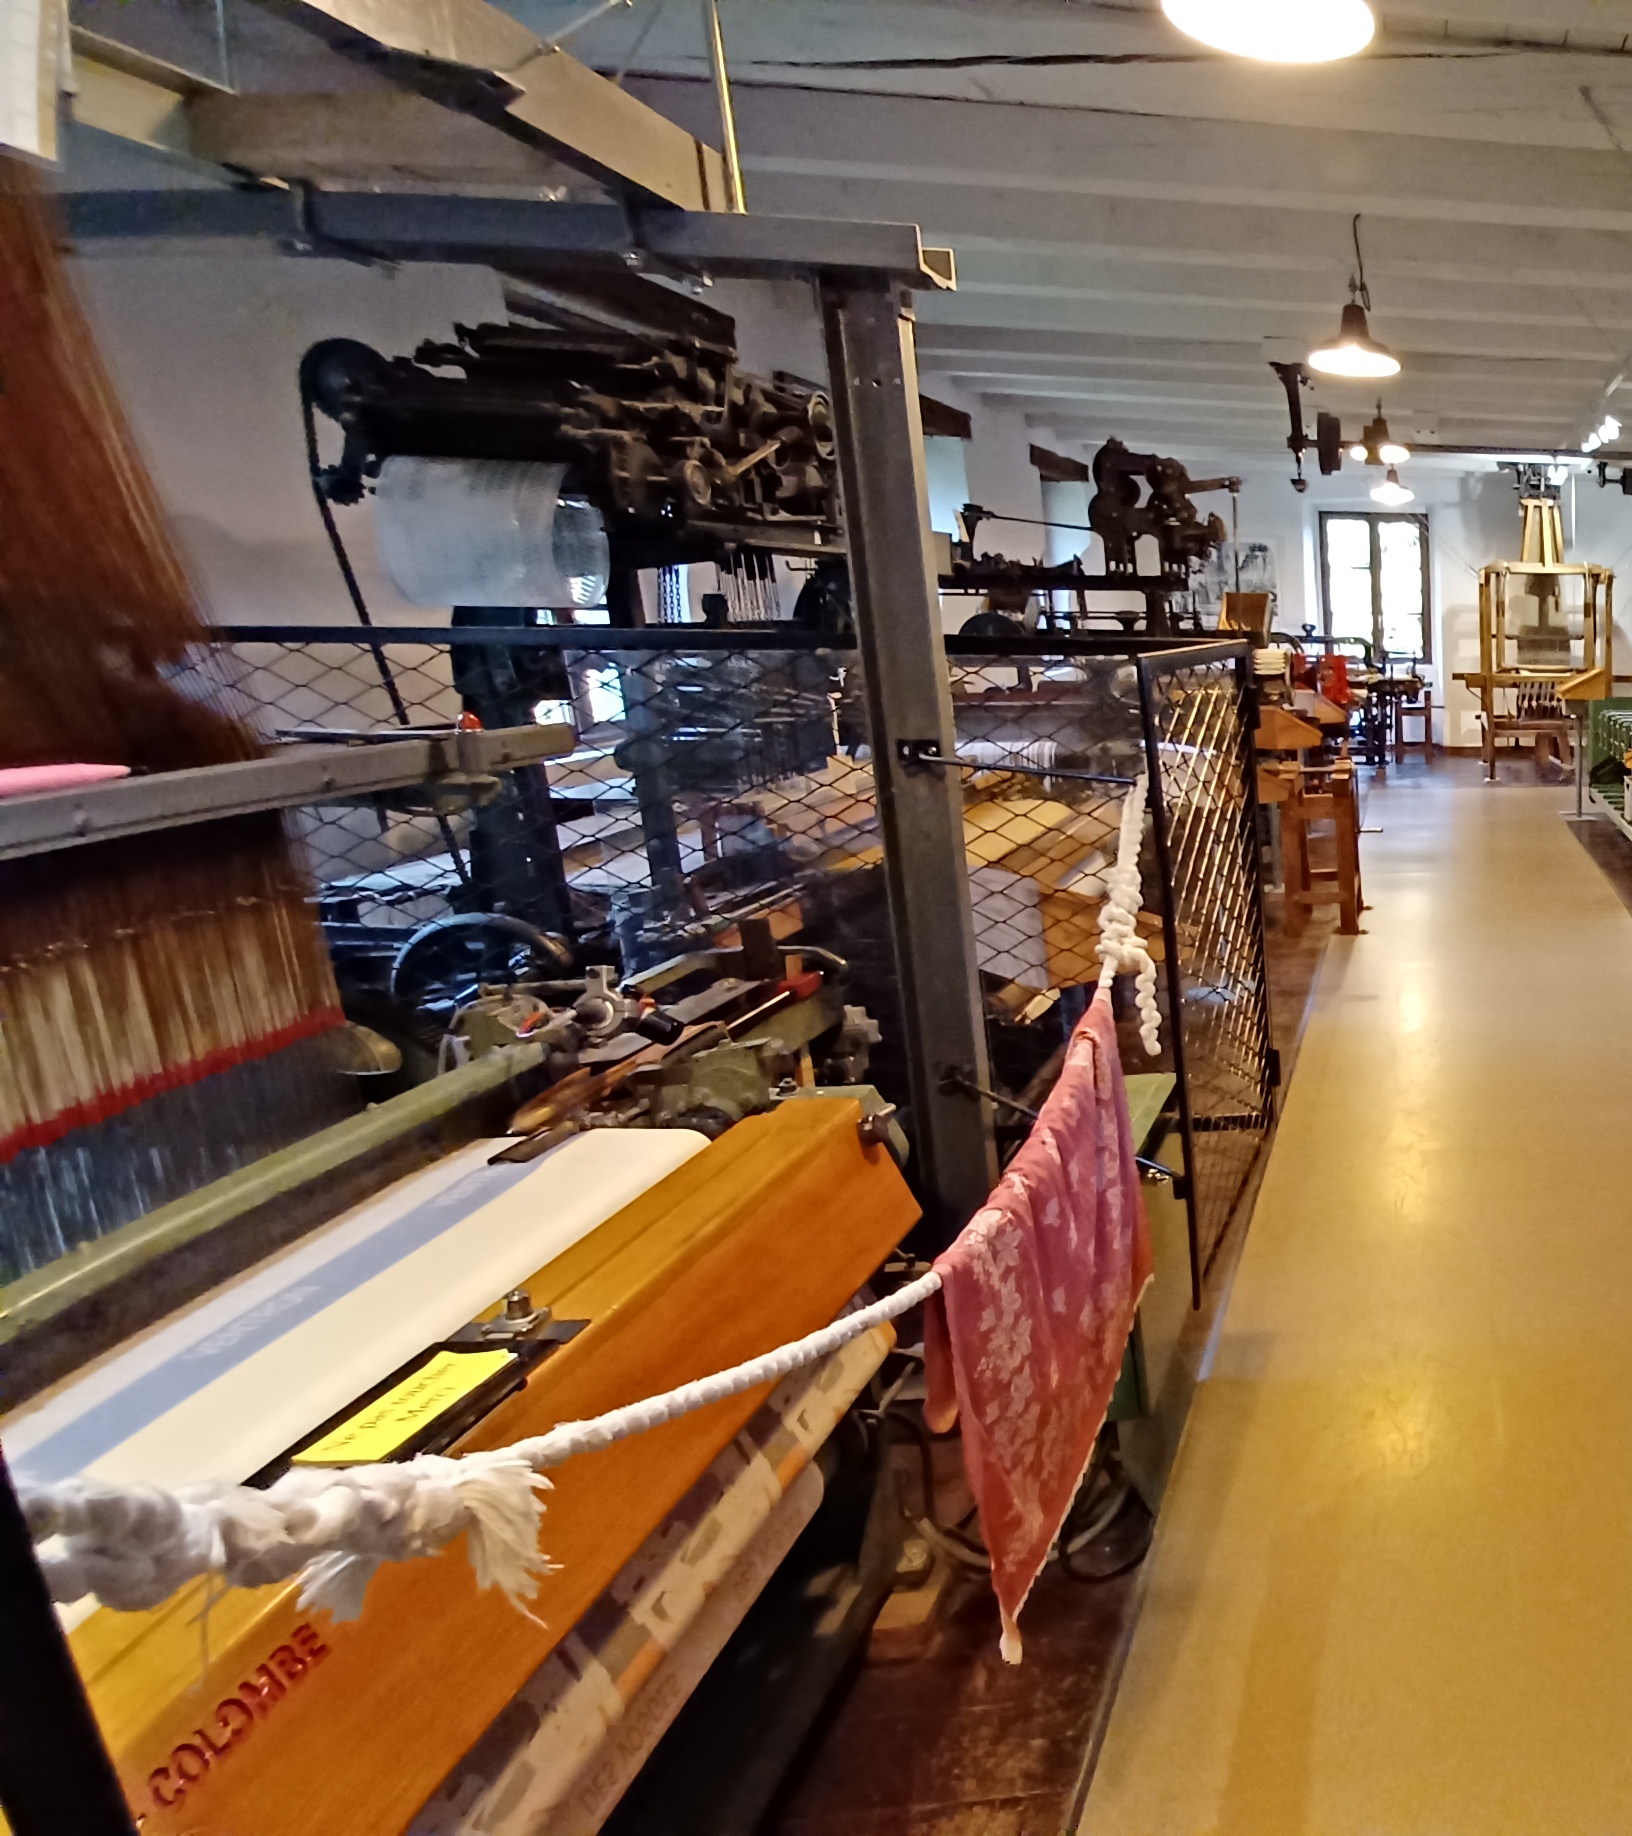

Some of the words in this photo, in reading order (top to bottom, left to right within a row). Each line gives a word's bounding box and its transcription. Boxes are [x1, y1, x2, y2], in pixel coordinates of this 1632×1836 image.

[359, 1407, 394, 1430] pas
[395, 1386, 456, 1423] Merci
[148, 1622, 333, 1808] COLOMBE
